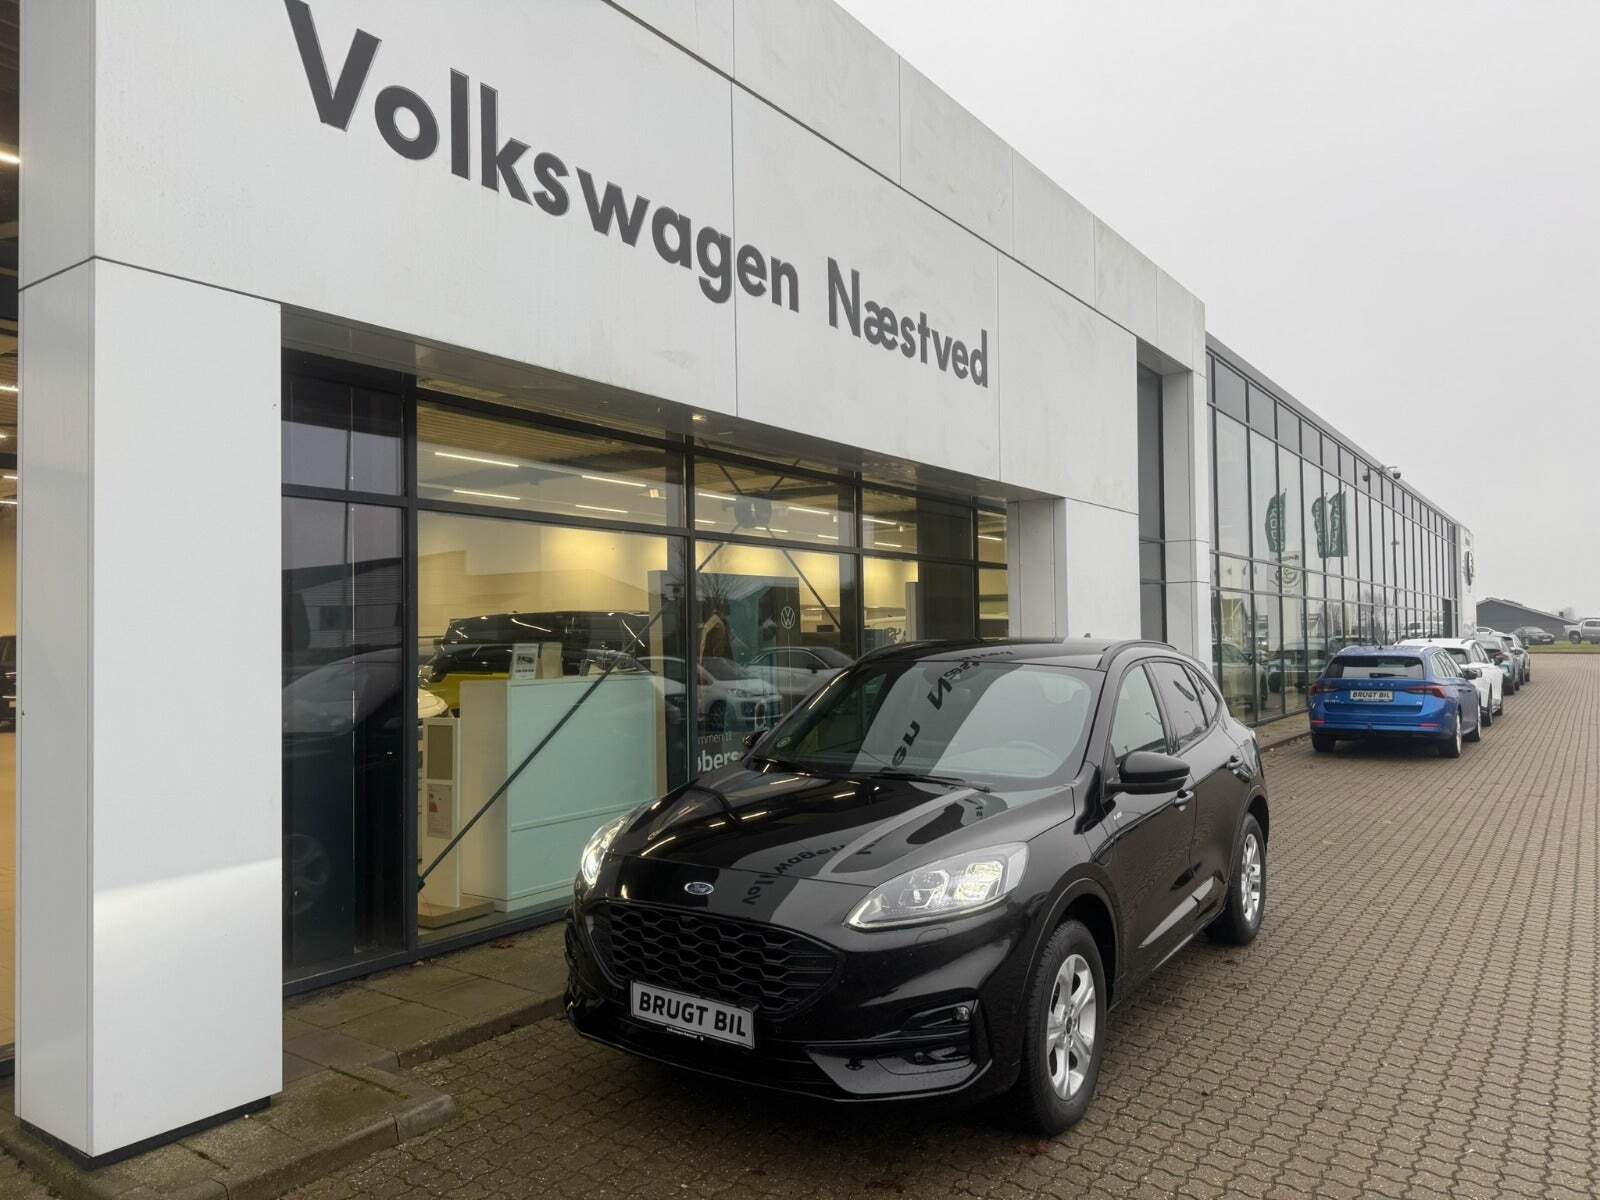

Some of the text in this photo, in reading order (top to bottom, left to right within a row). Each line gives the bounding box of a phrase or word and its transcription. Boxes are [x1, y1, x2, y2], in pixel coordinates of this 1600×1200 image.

[284, 0, 990, 389] Volkswagen Næstved
[639, 991, 709, 1026] BRUGT
[714, 1009, 746, 1037] BIL
